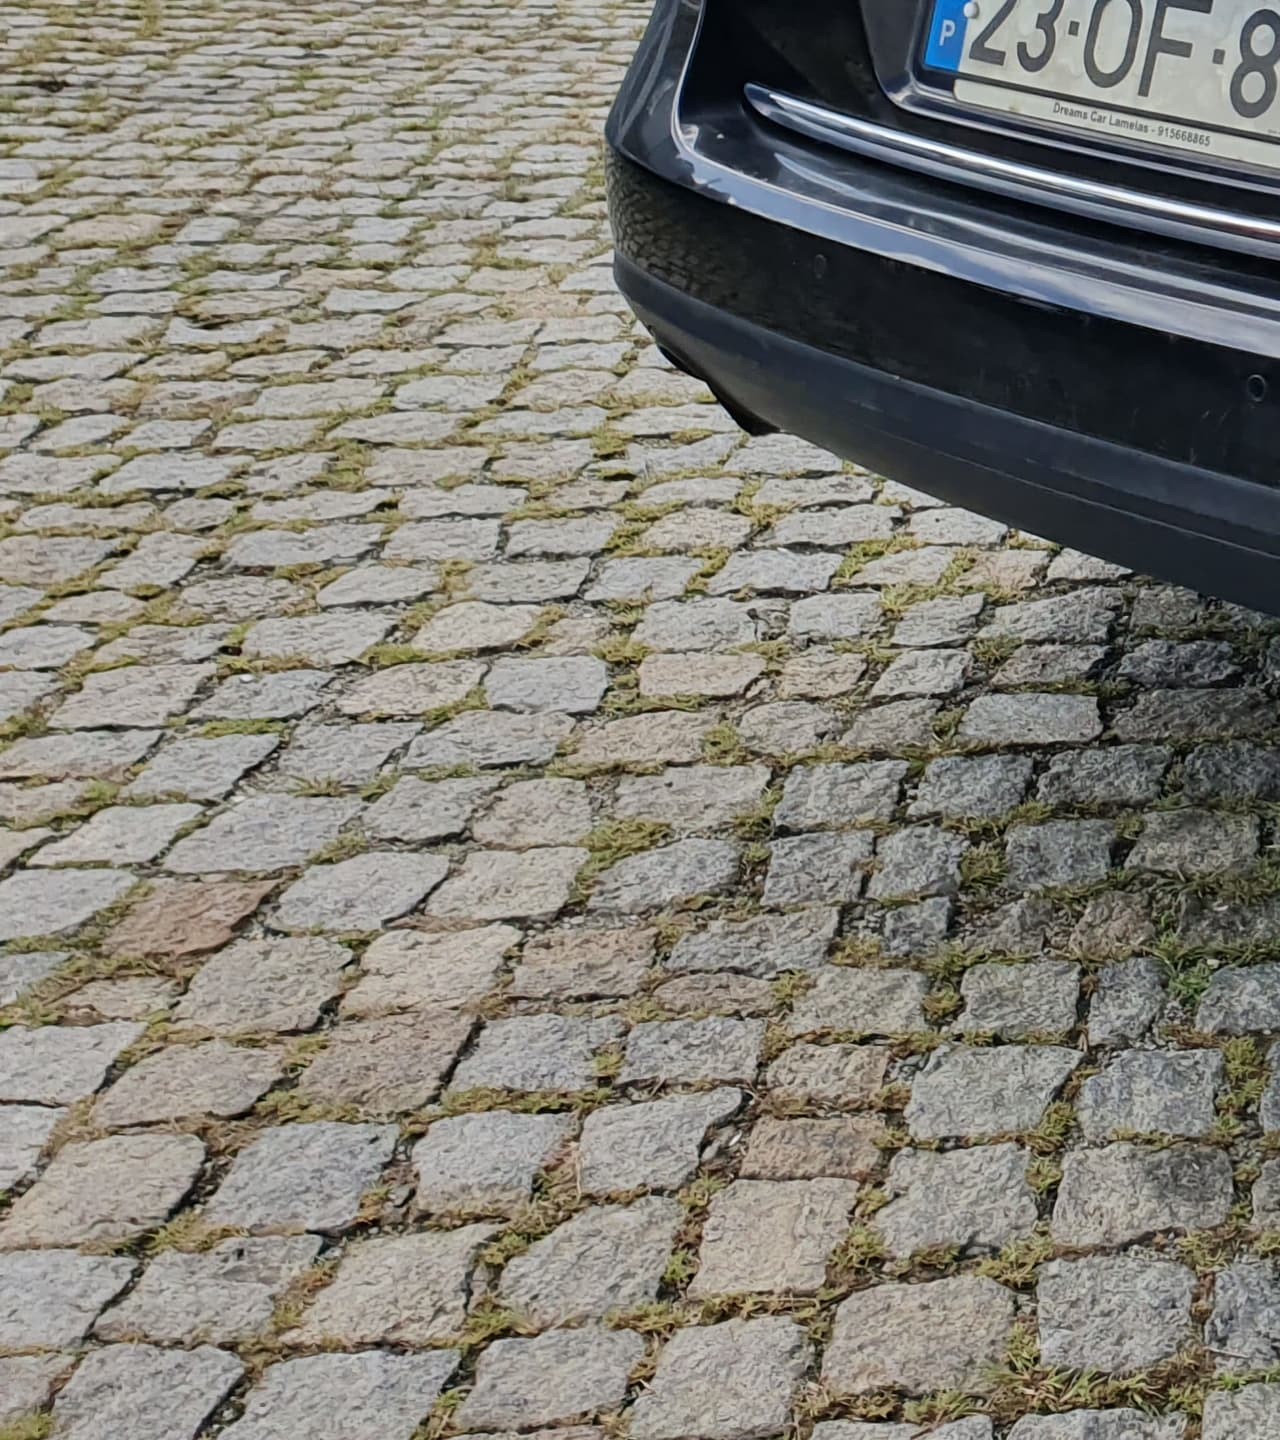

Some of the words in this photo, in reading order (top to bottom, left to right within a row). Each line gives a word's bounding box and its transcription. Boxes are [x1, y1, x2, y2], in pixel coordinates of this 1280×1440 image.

[939, 19, 956, 47] P
[1052, 102, 1088, 120] Dreams
[1090, 111, 1106, 123] Car
